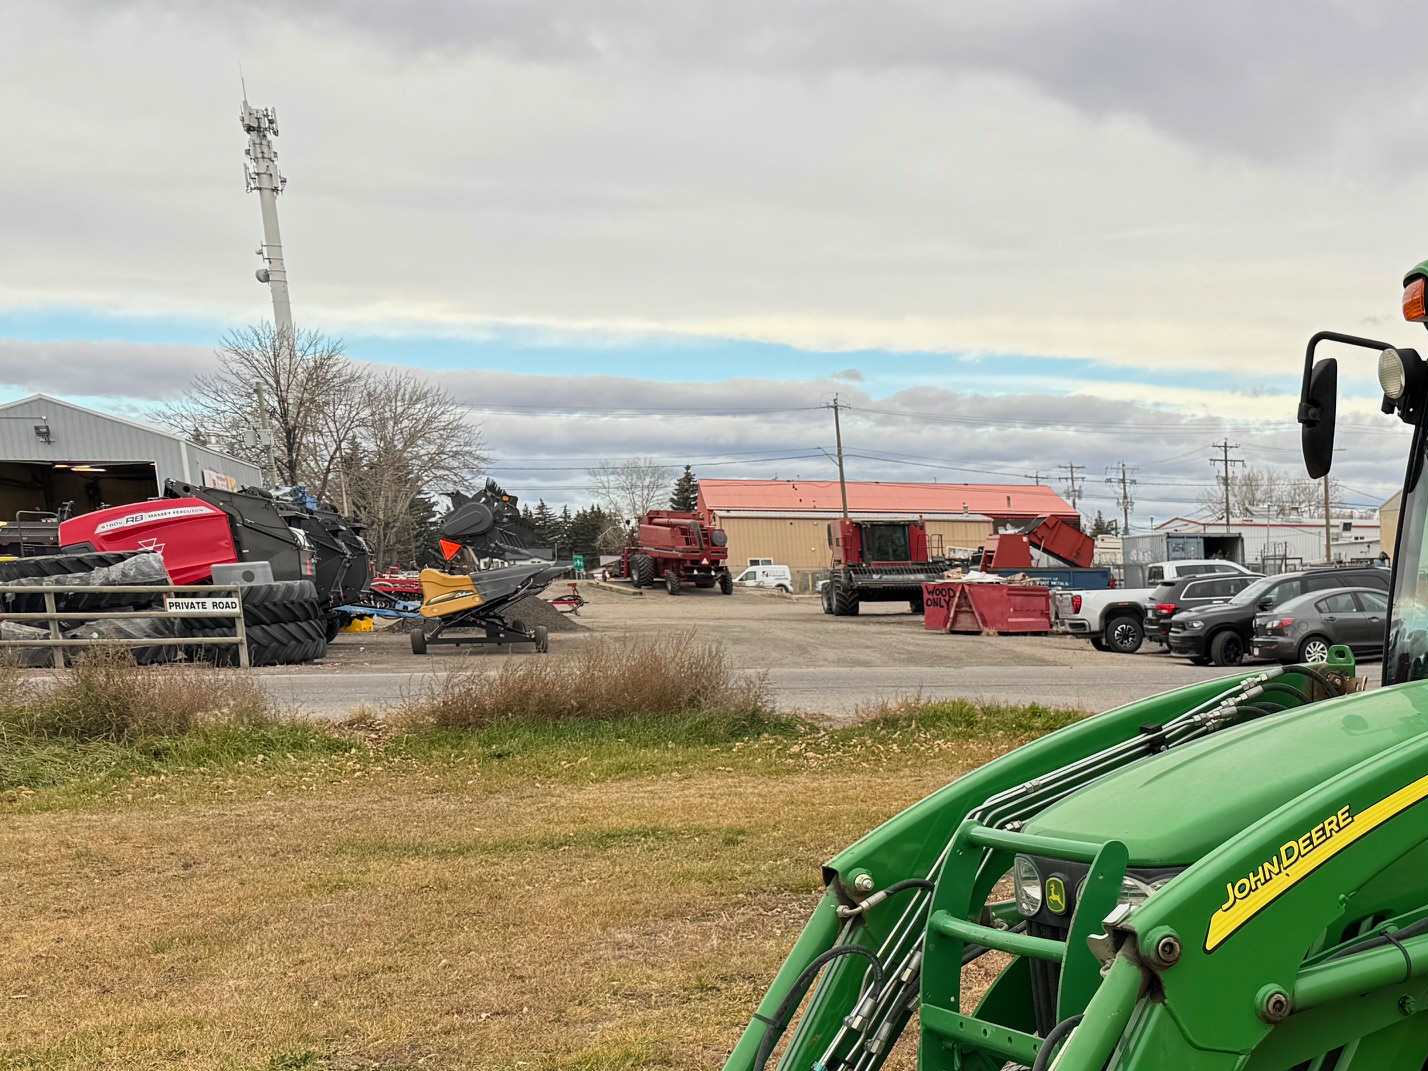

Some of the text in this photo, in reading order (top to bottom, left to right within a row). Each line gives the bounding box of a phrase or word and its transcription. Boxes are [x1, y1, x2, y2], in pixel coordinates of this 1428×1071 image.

[925, 586, 956, 598] WOOD
[168, 601, 237, 610] PRIVATE ROAD
[925, 597, 951, 610] ONLY
[1221, 804, 1353, 911] JOHN DEERE
